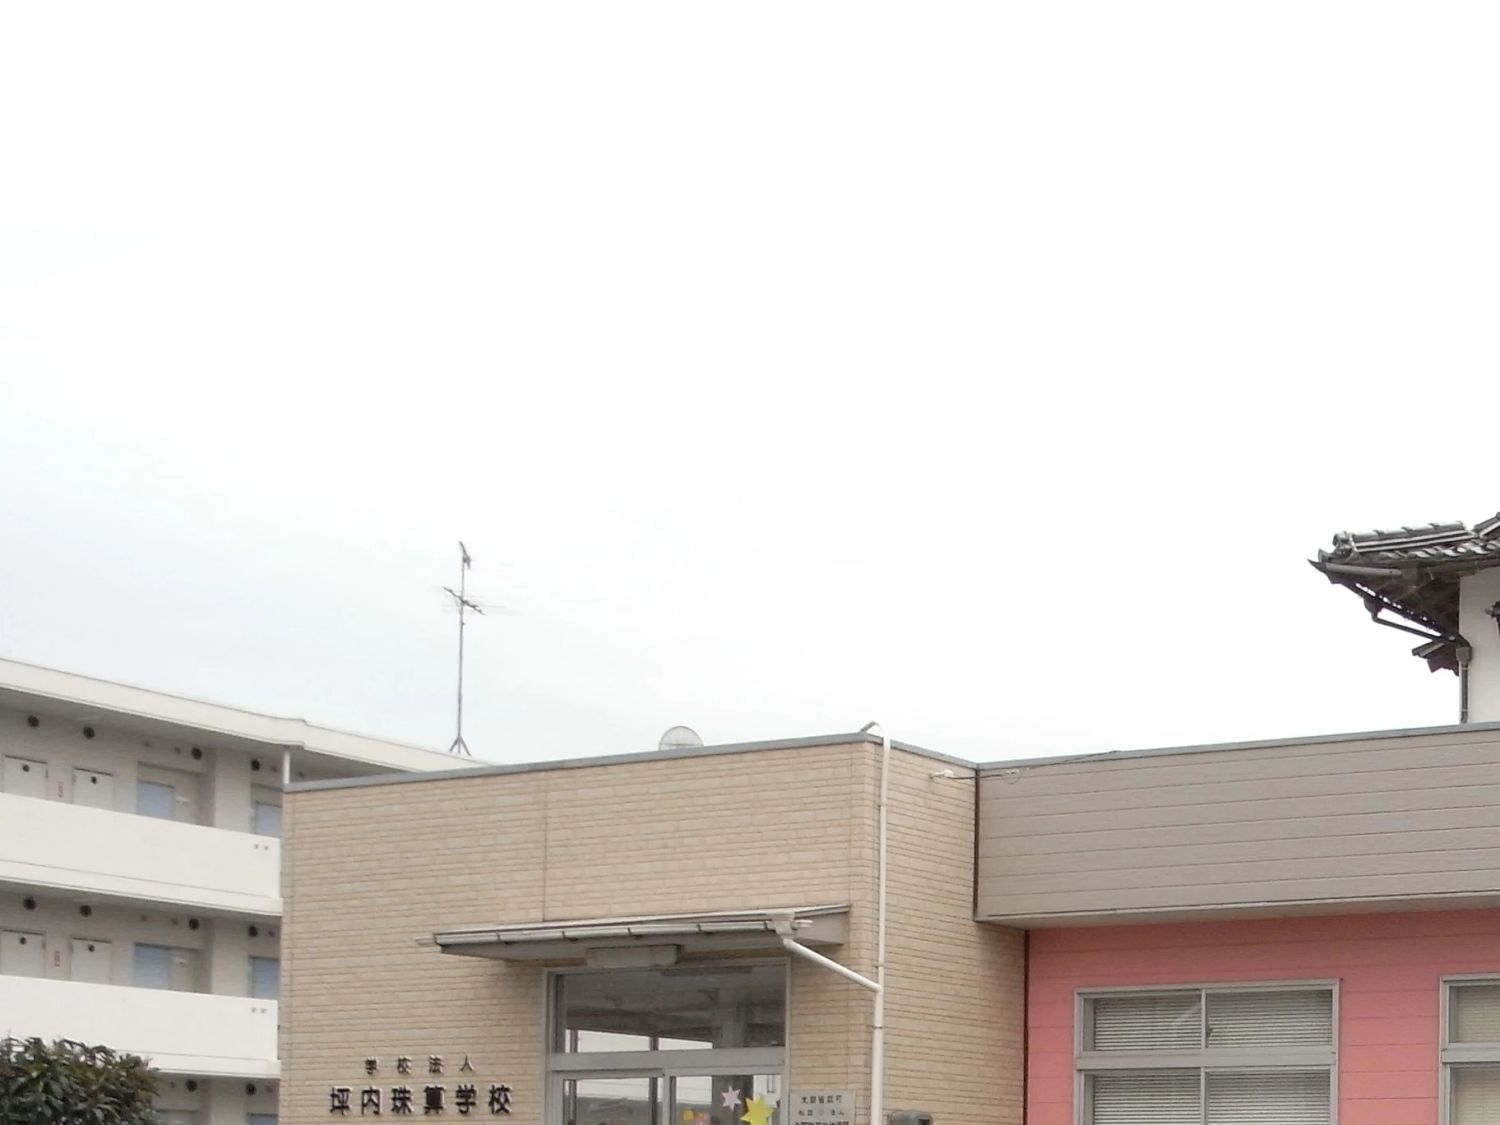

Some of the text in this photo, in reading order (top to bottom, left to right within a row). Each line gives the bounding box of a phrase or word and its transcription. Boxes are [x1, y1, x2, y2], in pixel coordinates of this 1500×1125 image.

[364, 1054, 475, 1075] 学校法人
[329, 1084, 513, 1116] 坪内珠算学校
